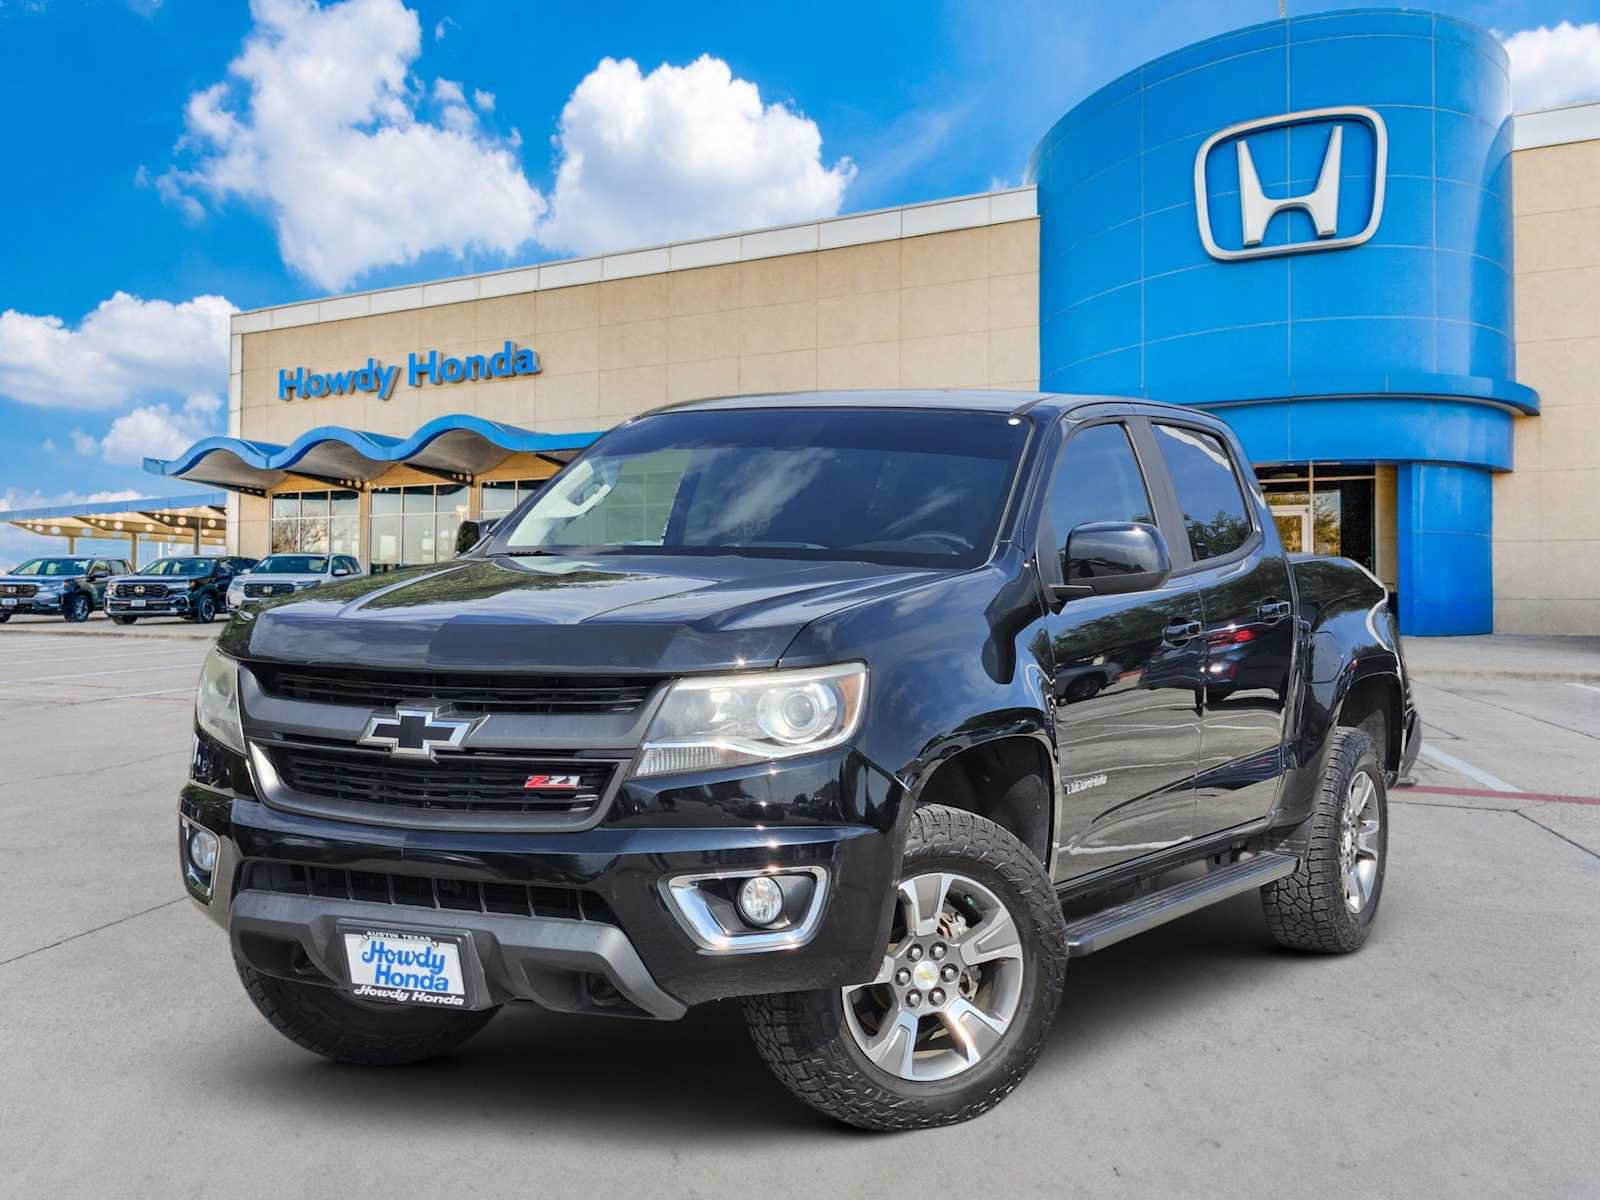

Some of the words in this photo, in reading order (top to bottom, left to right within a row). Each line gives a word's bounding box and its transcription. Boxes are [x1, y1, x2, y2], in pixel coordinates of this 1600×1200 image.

[278, 357, 401, 401] Howdy
[407, 340, 542, 388] Honda
[366, 931, 399, 939] AUSTIN
[401, 934, 432, 942] TEXAS
[362, 940, 446, 975] Howdy
[375, 964, 449, 991] Honda
[354, 984, 410, 1002] Howdy
[412, 993, 465, 1005] Honda
